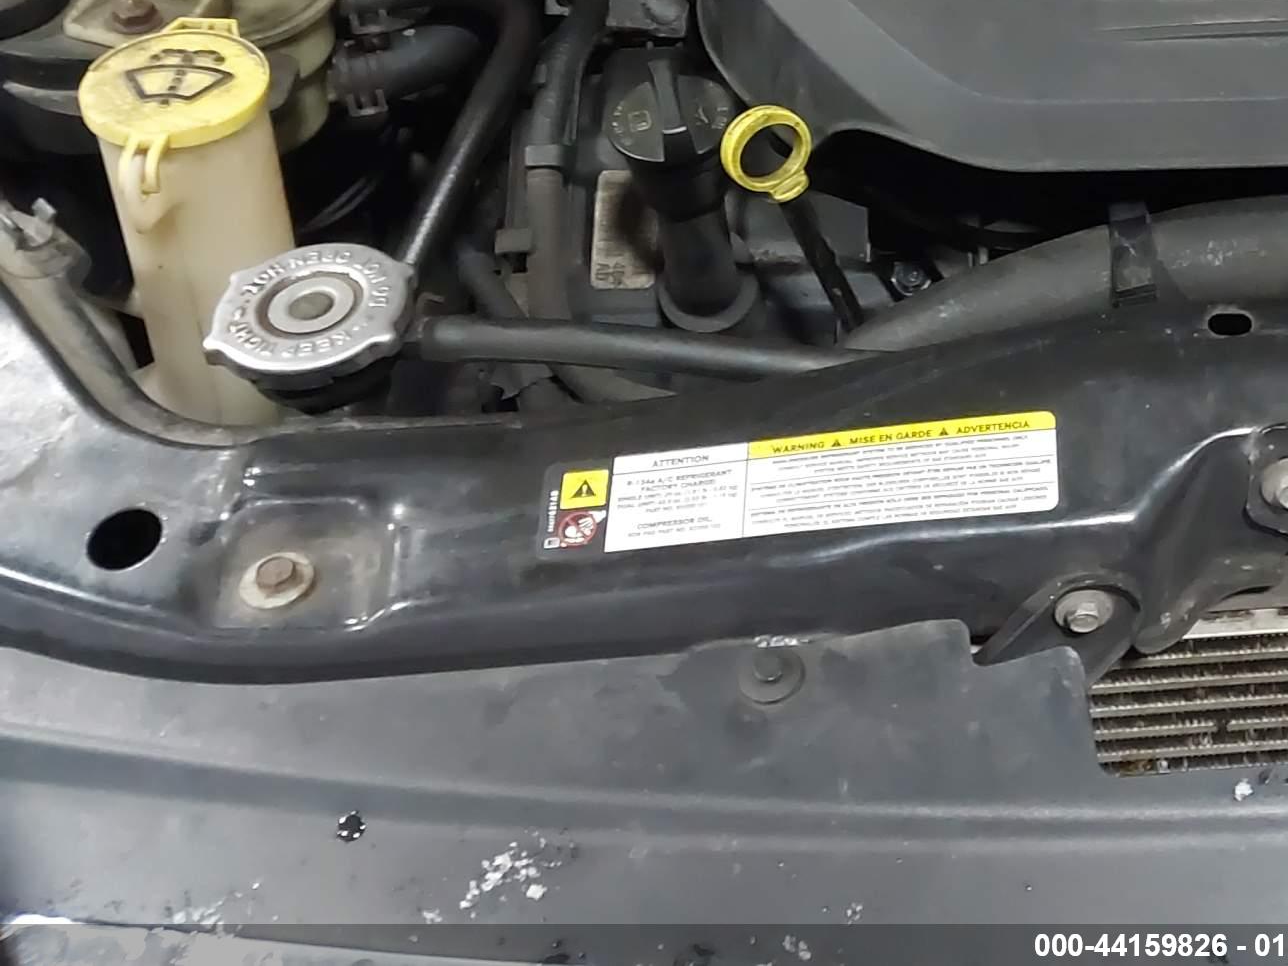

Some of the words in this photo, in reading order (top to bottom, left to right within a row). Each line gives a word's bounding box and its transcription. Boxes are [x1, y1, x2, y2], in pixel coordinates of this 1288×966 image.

[289, 251, 351, 269] OPEN
[280, 330, 350, 359] KEEP
[772, 442, 825, 454] WARNING
[850, 434, 875, 445] MISE
[879, 433, 893, 443] EN
[896, 429, 932, 441] GARDE
[956, 420, 1031, 435] ADVERTENCIA
[652, 454, 710, 468] ATTENTION
